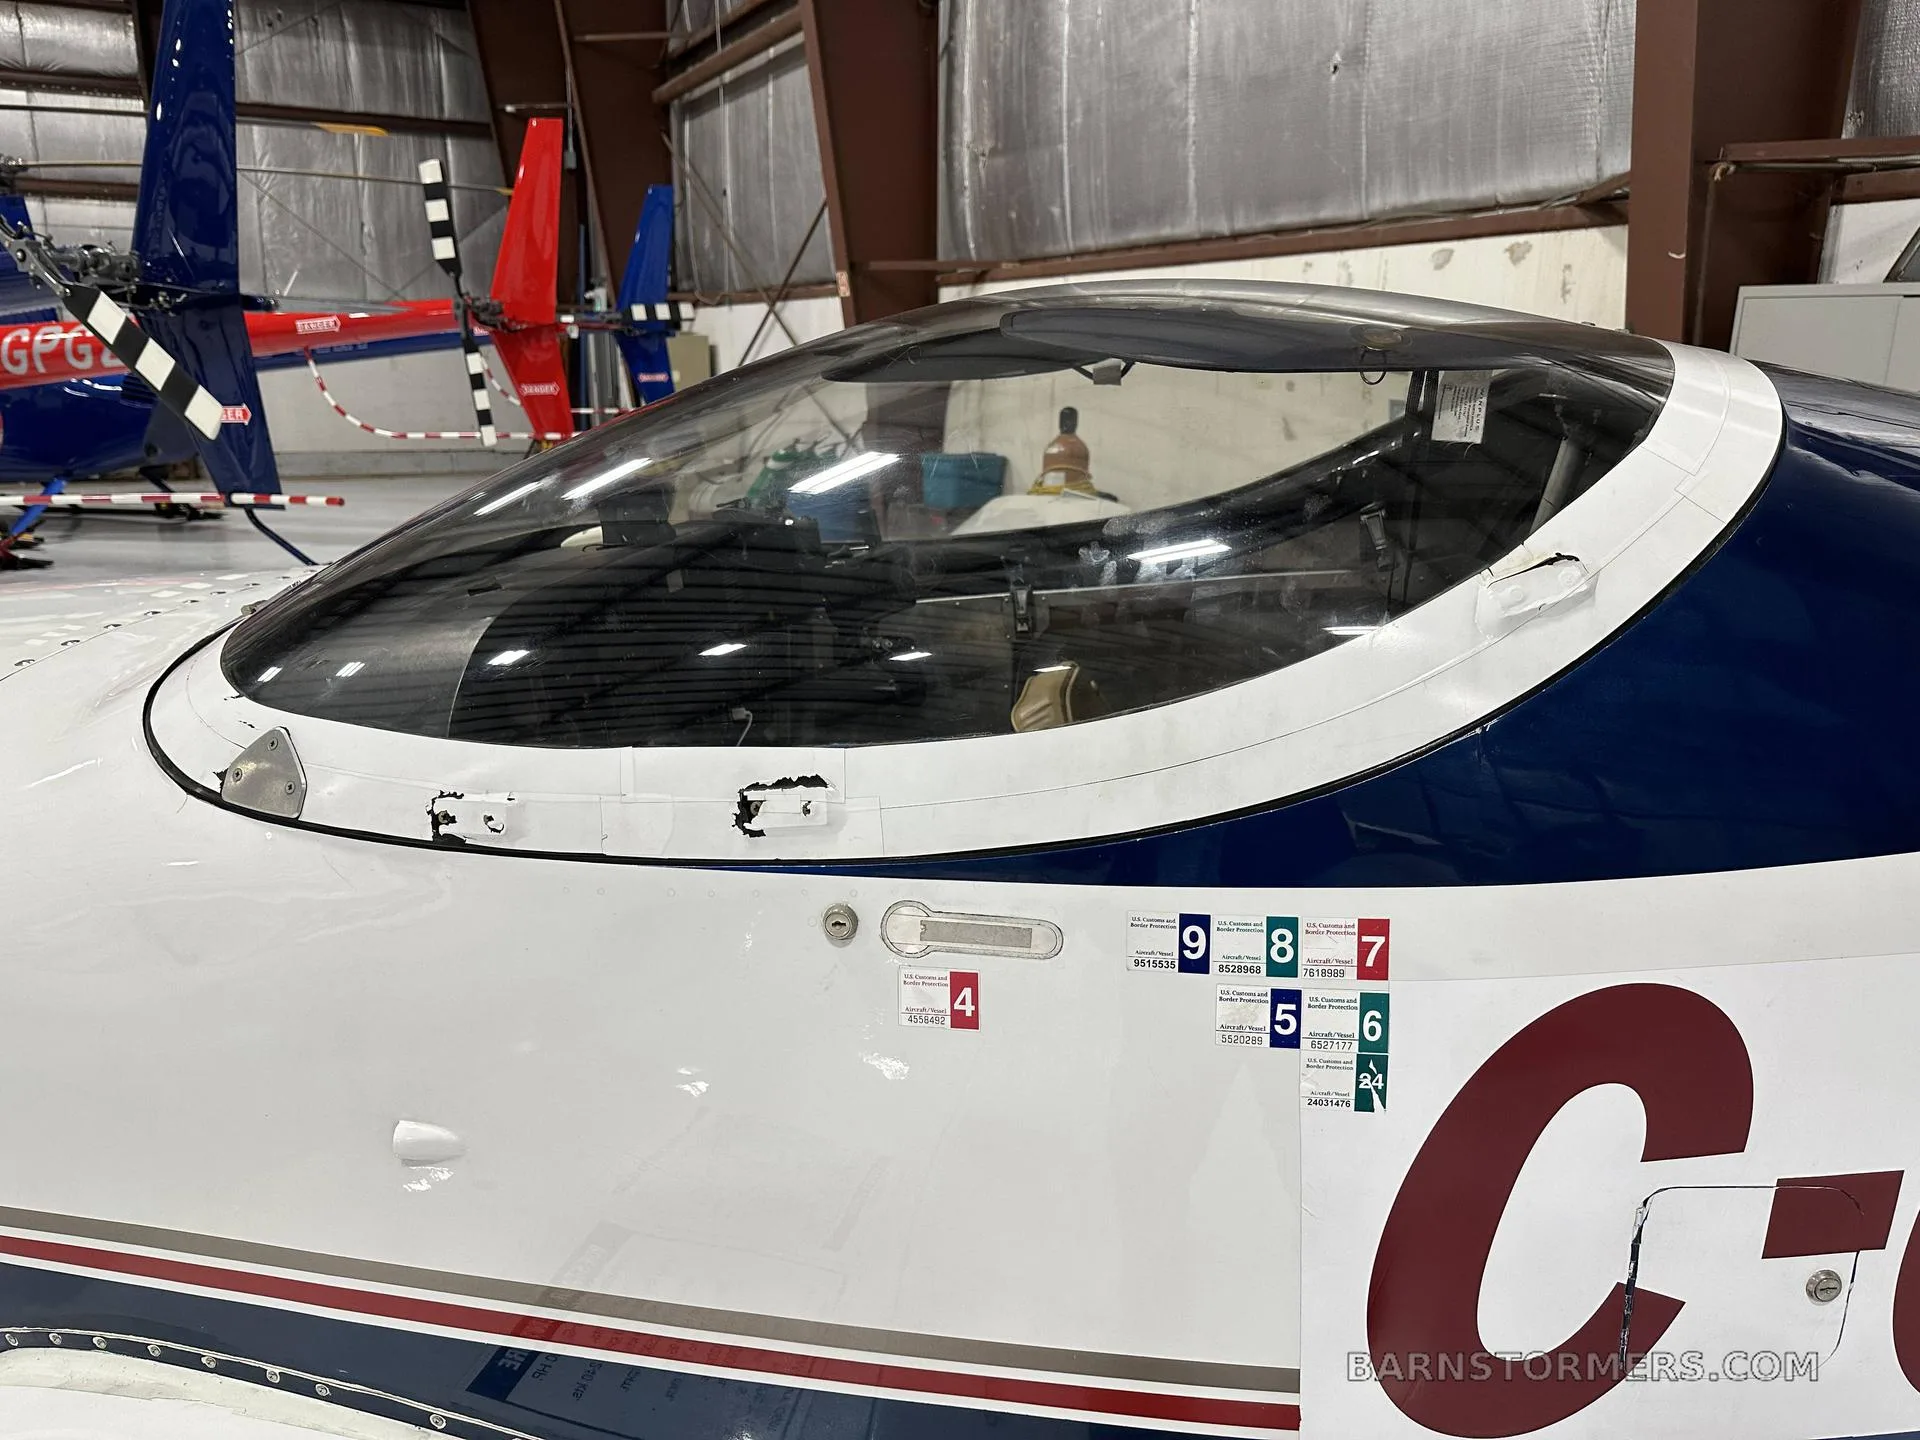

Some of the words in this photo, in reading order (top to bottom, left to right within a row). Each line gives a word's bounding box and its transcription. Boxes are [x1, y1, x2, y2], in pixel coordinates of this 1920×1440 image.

[1182, 925, 1206, 960] 9
[1270, 928, 1294, 964] 8
[1361, 935, 1386, 967] 7
[1133, 959, 1176, 969] 9515535
[1218, 964, 1261, 974] 8528968
[1303, 968, 1345, 977] 7618989
[953, 987, 975, 1017] 4
[908, 1015, 945, 1025] 4558492
[1274, 1003, 1297, 1035] 5
[1363, 1010, 1382, 1042] 6
[1221, 1035, 1263, 1045] 5520289
[1310, 1040, 1353, 1050] 6527177
[1358, 1072, 1384, 1089] 24
[1307, 1098, 1351, 1107] 24031476
[1366, 982, 1920, 1439] C-
